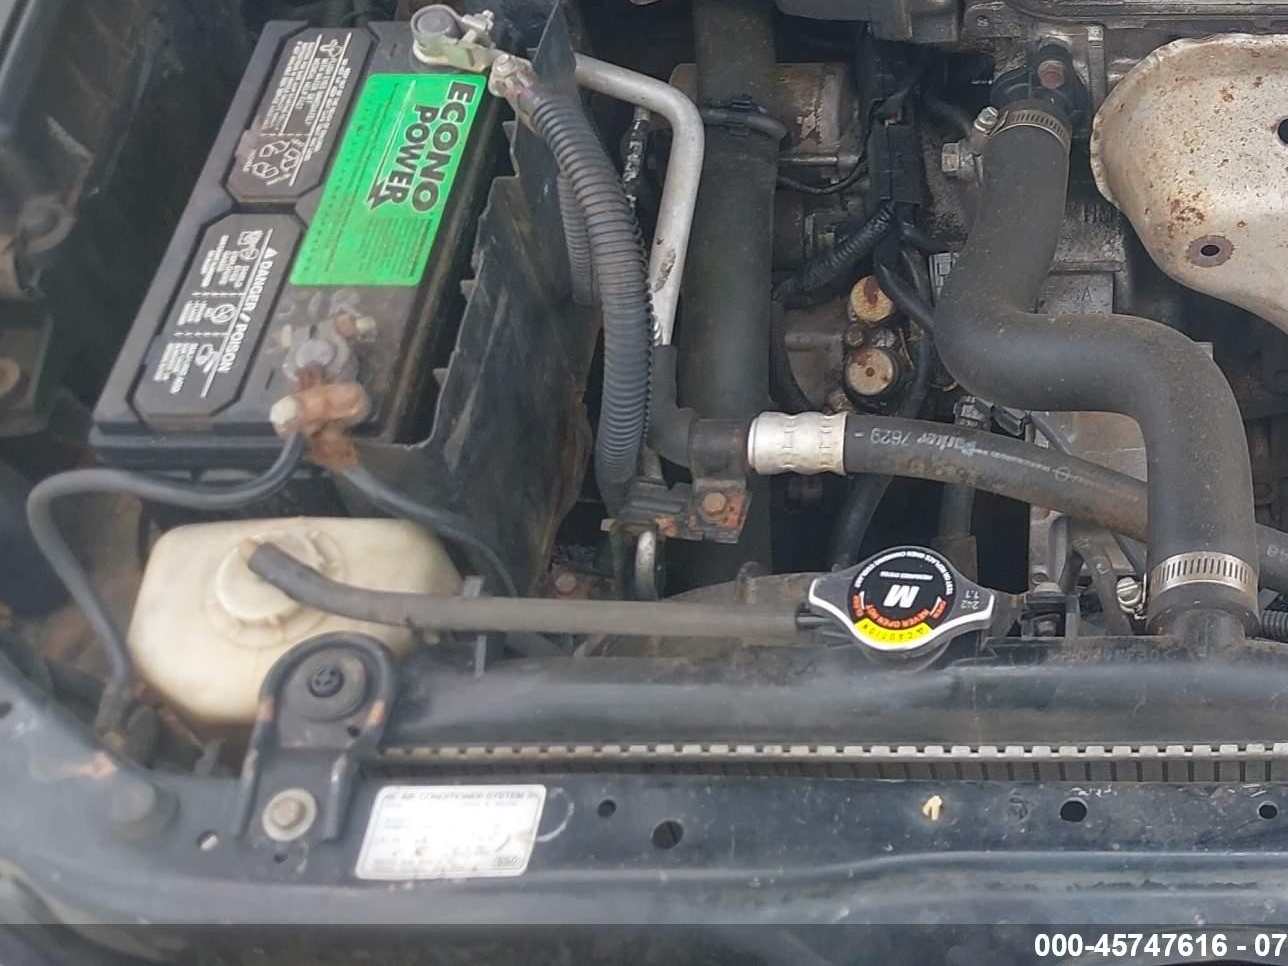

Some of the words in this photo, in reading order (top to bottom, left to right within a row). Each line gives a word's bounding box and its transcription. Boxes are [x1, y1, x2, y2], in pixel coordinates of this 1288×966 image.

[368, 104, 440, 210] POWER
[411, 81, 477, 212] ECONO
[241, 260, 274, 312] DANGER
[216, 323, 248, 372] POISON
[917, 431, 976, 458] Parker
[960, 600, 979, 608] 242
[863, 623, 912, 640] CAUTION
